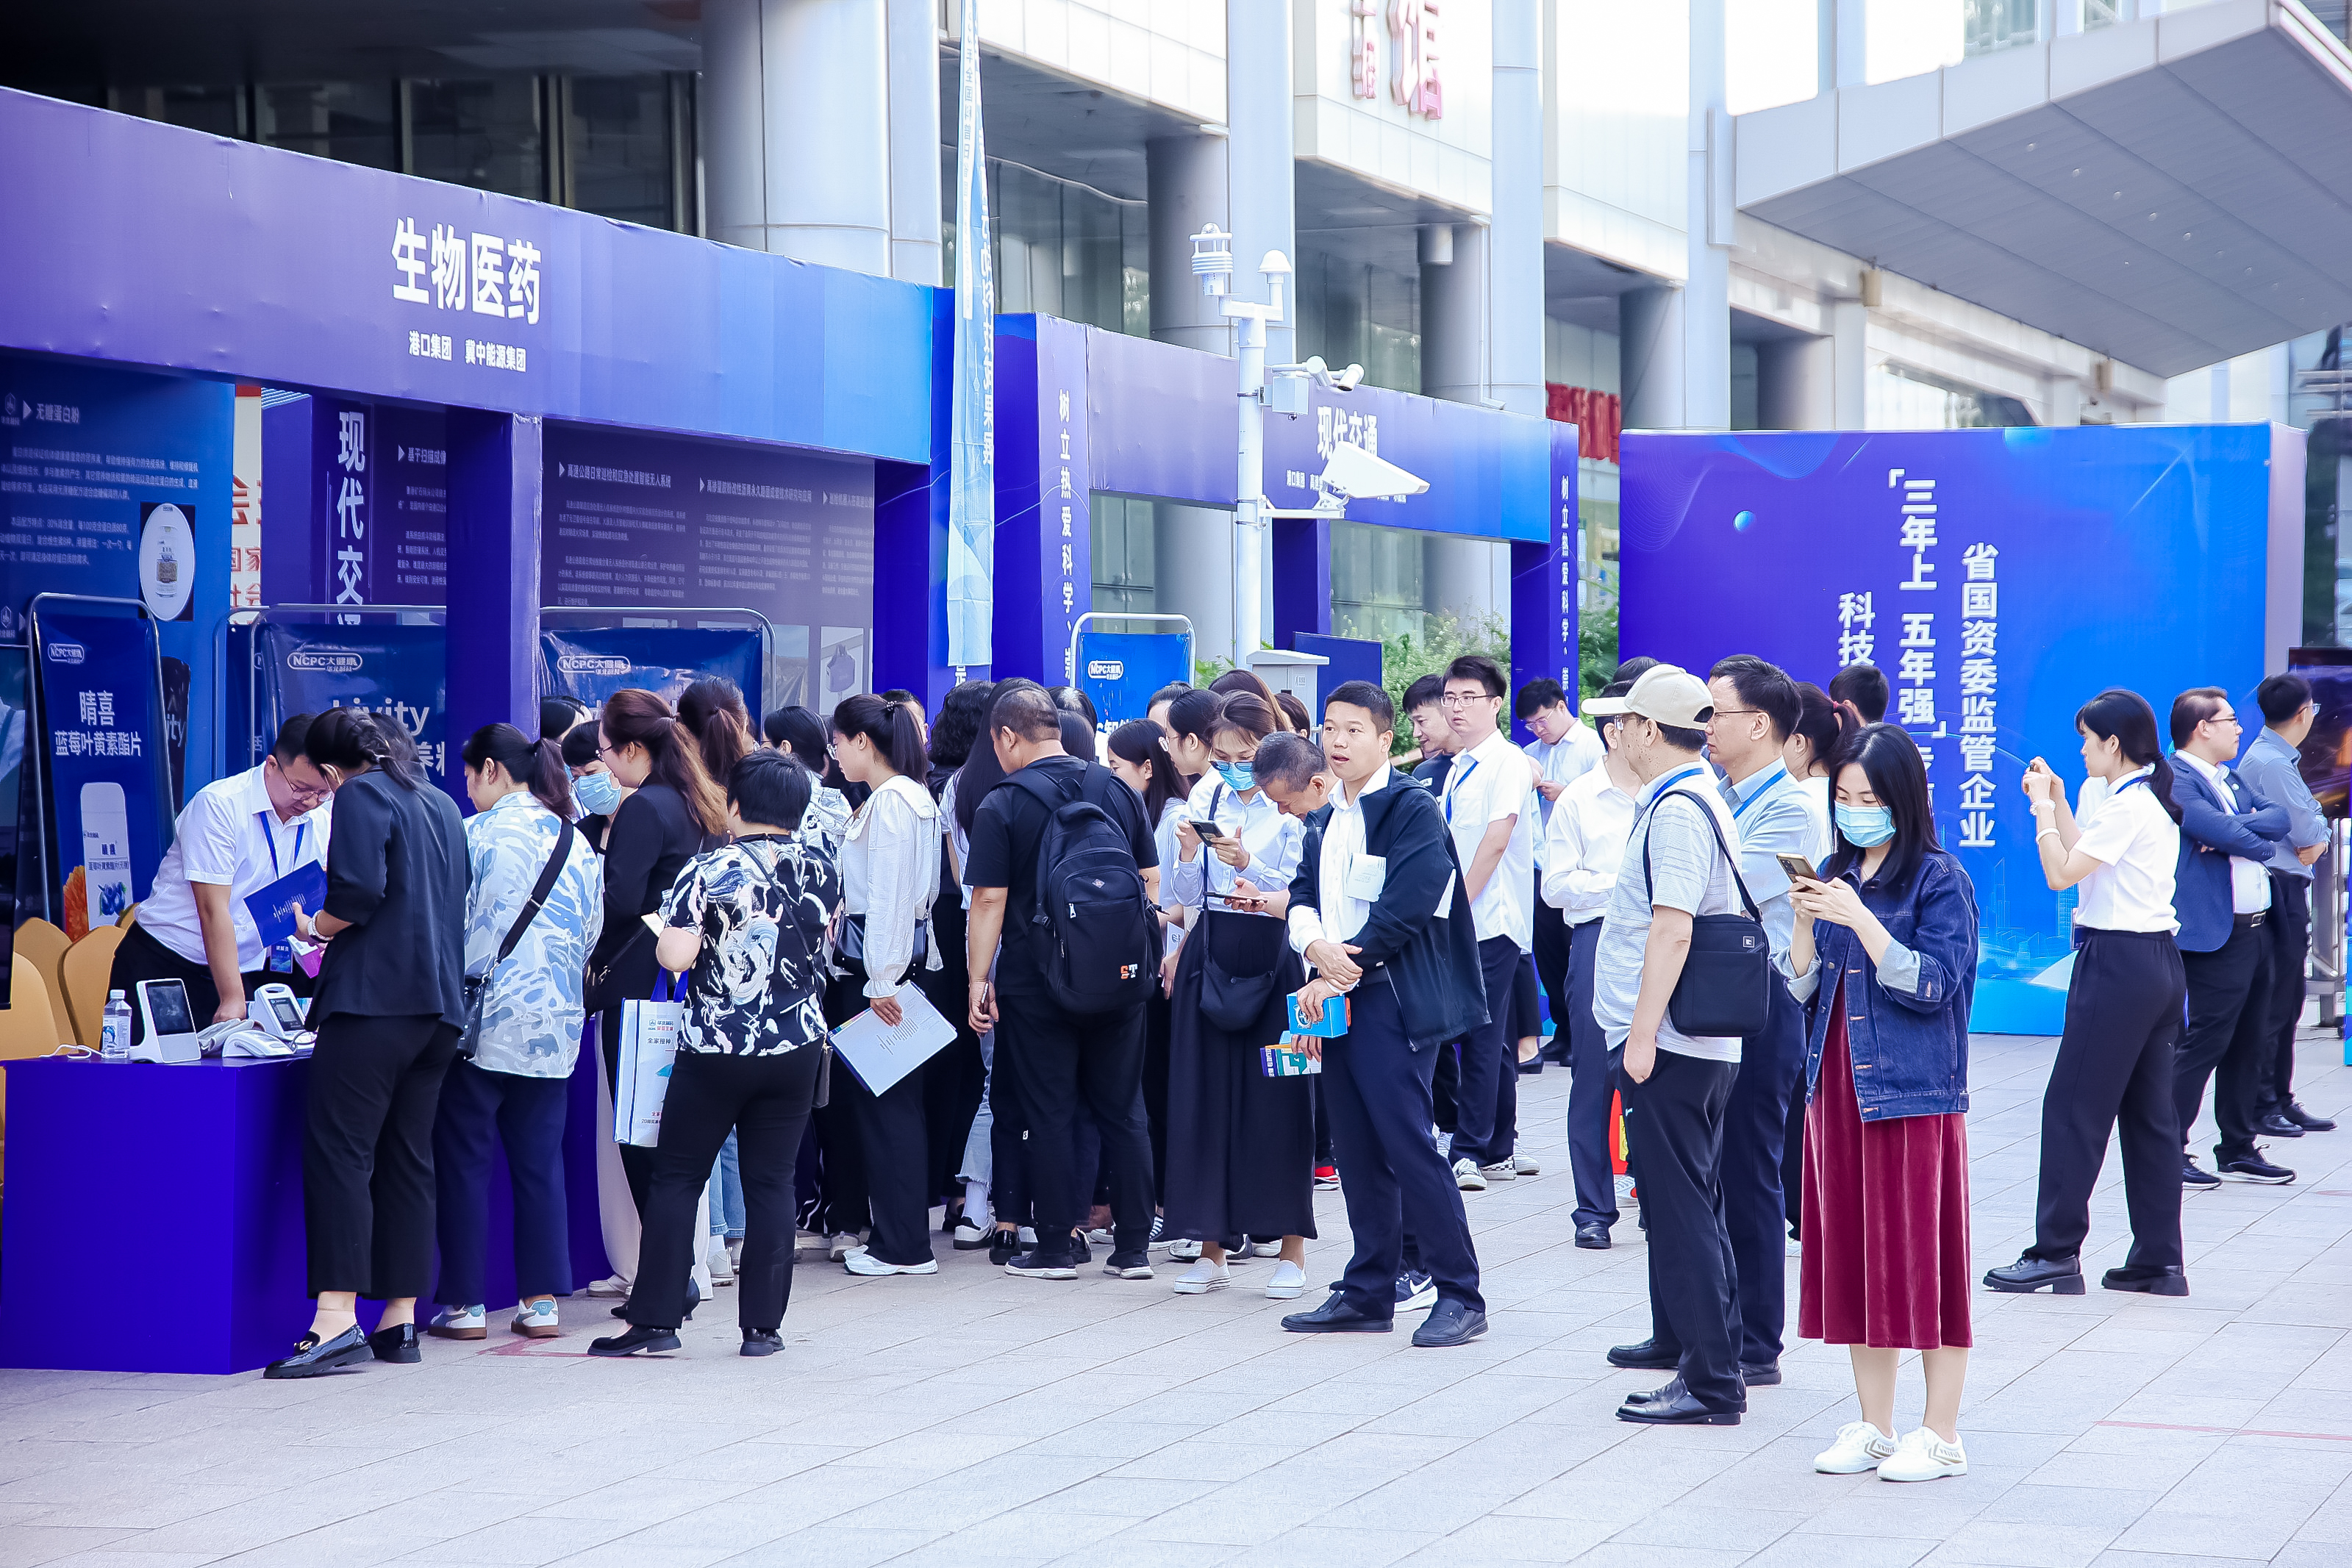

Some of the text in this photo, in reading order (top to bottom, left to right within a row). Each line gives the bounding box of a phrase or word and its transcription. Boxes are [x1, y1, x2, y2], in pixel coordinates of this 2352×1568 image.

[391, 215, 542, 325] 生物医药
[409, 329, 526, 372] 港口集团 冀中能源集团
[293, 654, 358, 666] NCPC大健康
[1958, 542, 1999, 848] 省国资委监管企业
[54, 730, 142, 757] 蓝莓叶黄素酯片
